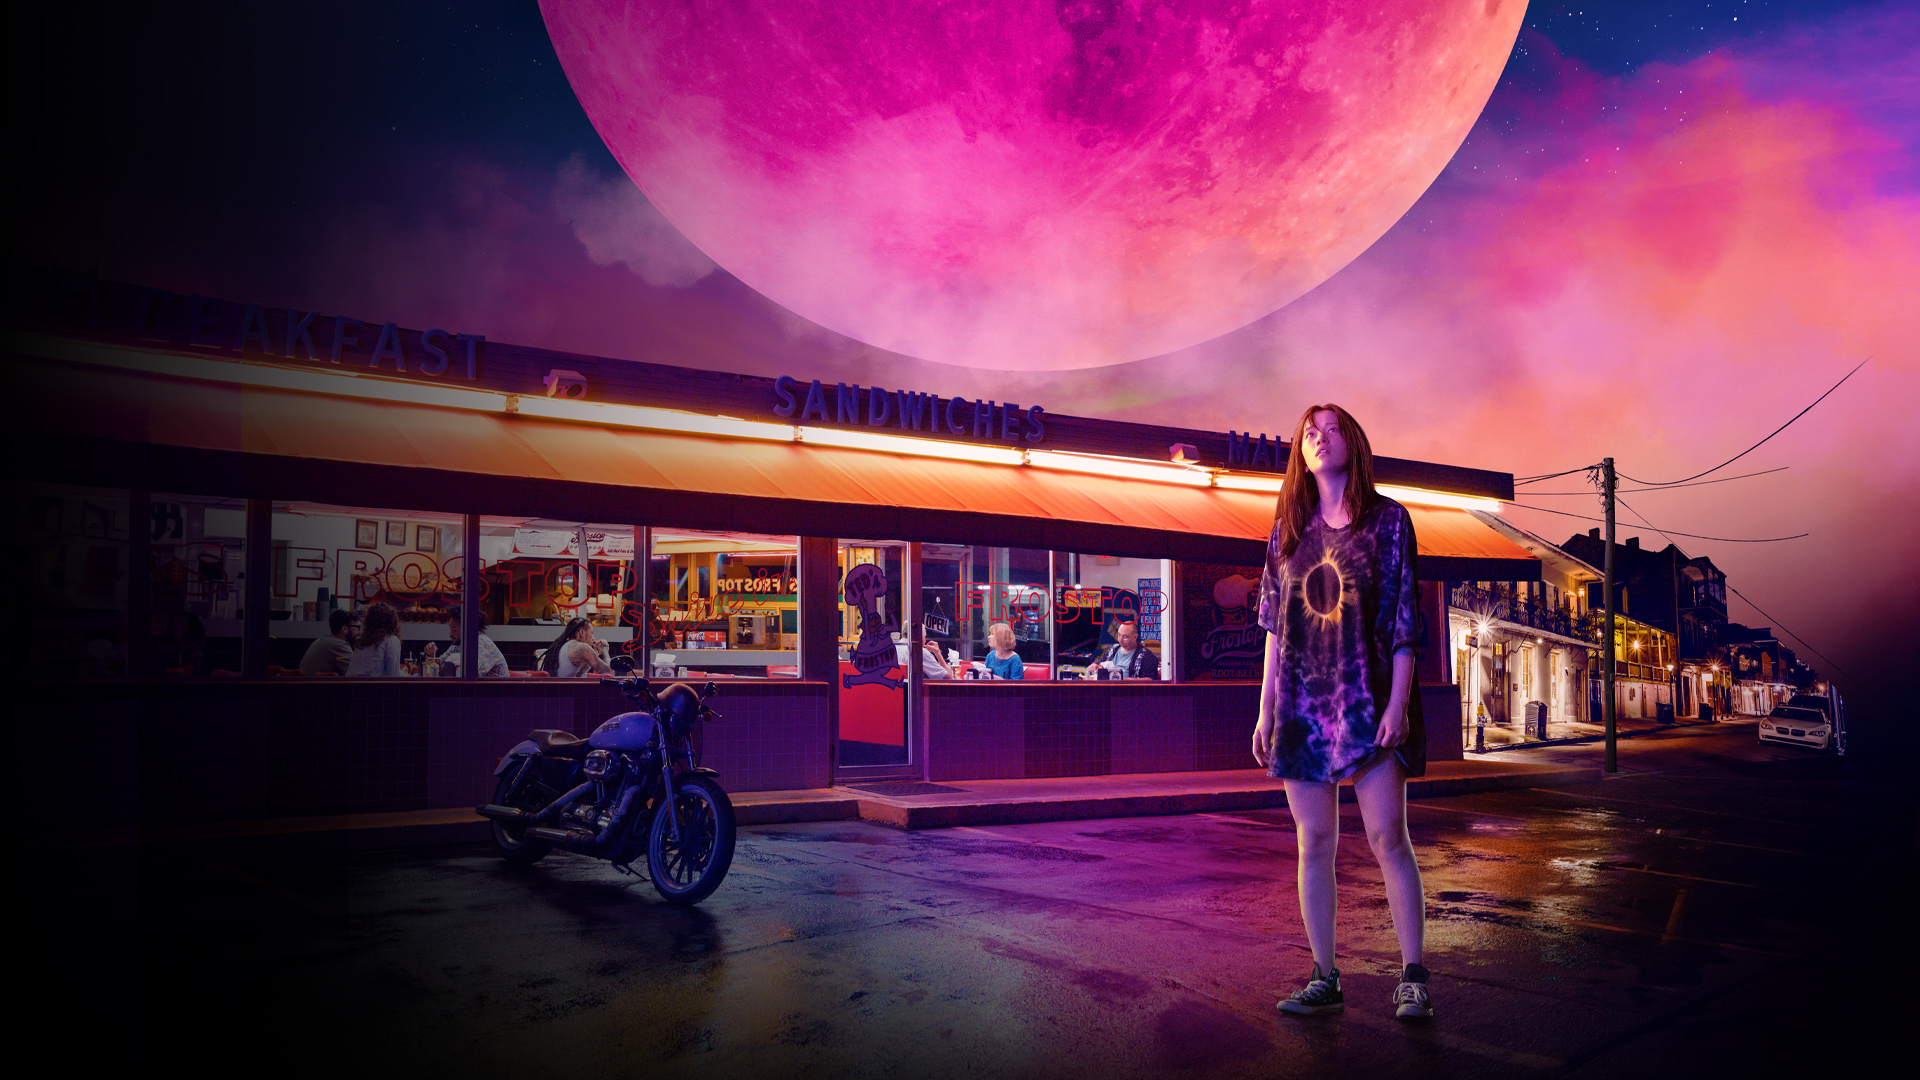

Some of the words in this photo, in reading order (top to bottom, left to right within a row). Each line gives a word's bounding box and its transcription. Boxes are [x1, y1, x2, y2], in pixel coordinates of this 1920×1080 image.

[773, 375, 1046, 443] SANDWICHES
[1228, 430, 1293, 470] MAL
[273, 546, 638, 609] FROSTOP
[846, 569, 882, 599] TED'S
[954, 582, 1169, 626] FROSTOP
[925, 614, 949, 634] OPEN
[1200, 621, 1267, 660] Frostop
[857, 647, 896, 669] FROSTOP
[1211, 668, 1236, 679] ROOT
[1237, 668, 1263, 679] BEER
